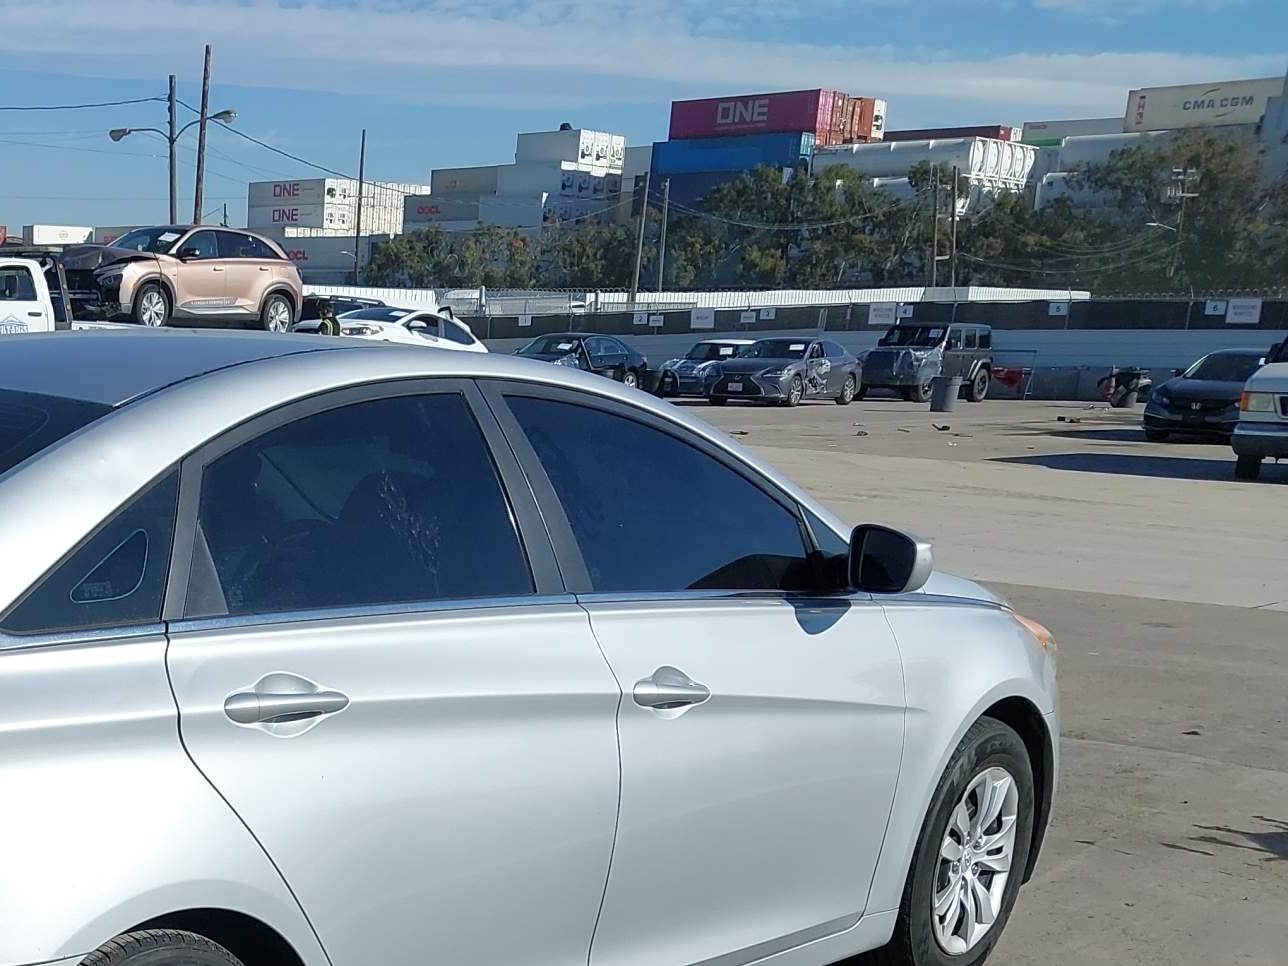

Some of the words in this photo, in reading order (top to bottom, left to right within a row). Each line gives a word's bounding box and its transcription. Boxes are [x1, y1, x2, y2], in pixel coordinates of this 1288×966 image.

[1182, 99, 1215, 111] CMA
[1220, 95, 1255, 108] CGM
[716, 100, 769, 124] ONE
[273, 183, 300, 198] ONE
[272, 208, 299, 222] ONE
[287, 249, 309, 261] OCL
